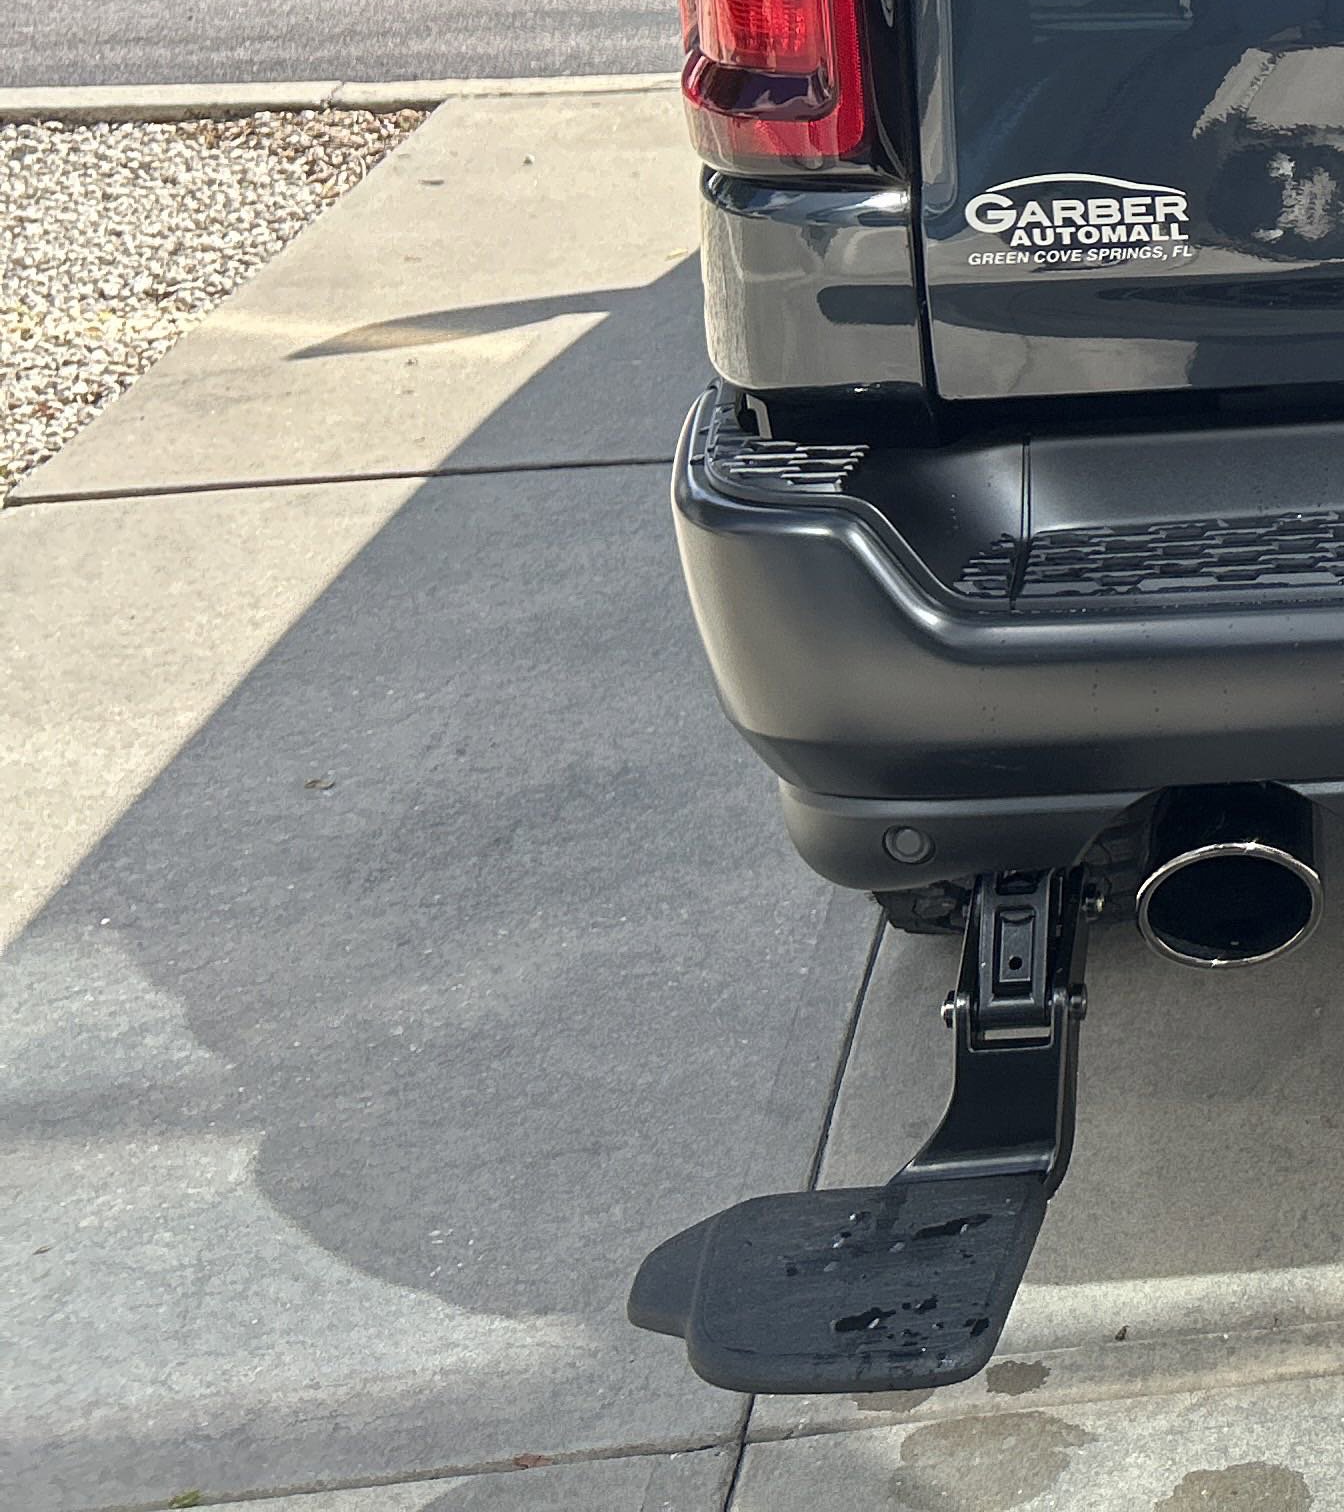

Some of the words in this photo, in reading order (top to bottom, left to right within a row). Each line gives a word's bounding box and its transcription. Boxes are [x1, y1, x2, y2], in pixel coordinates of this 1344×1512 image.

[965, 193, 1190, 234] GARBER
[1009, 223, 1189, 248] AUTOMALL
[967, 250, 1031, 266] GREEN
[1033, 248, 1084, 264] COVE
[1086, 246, 1169, 263] SPRINGS,
[1172, 244, 1193, 259] FL
